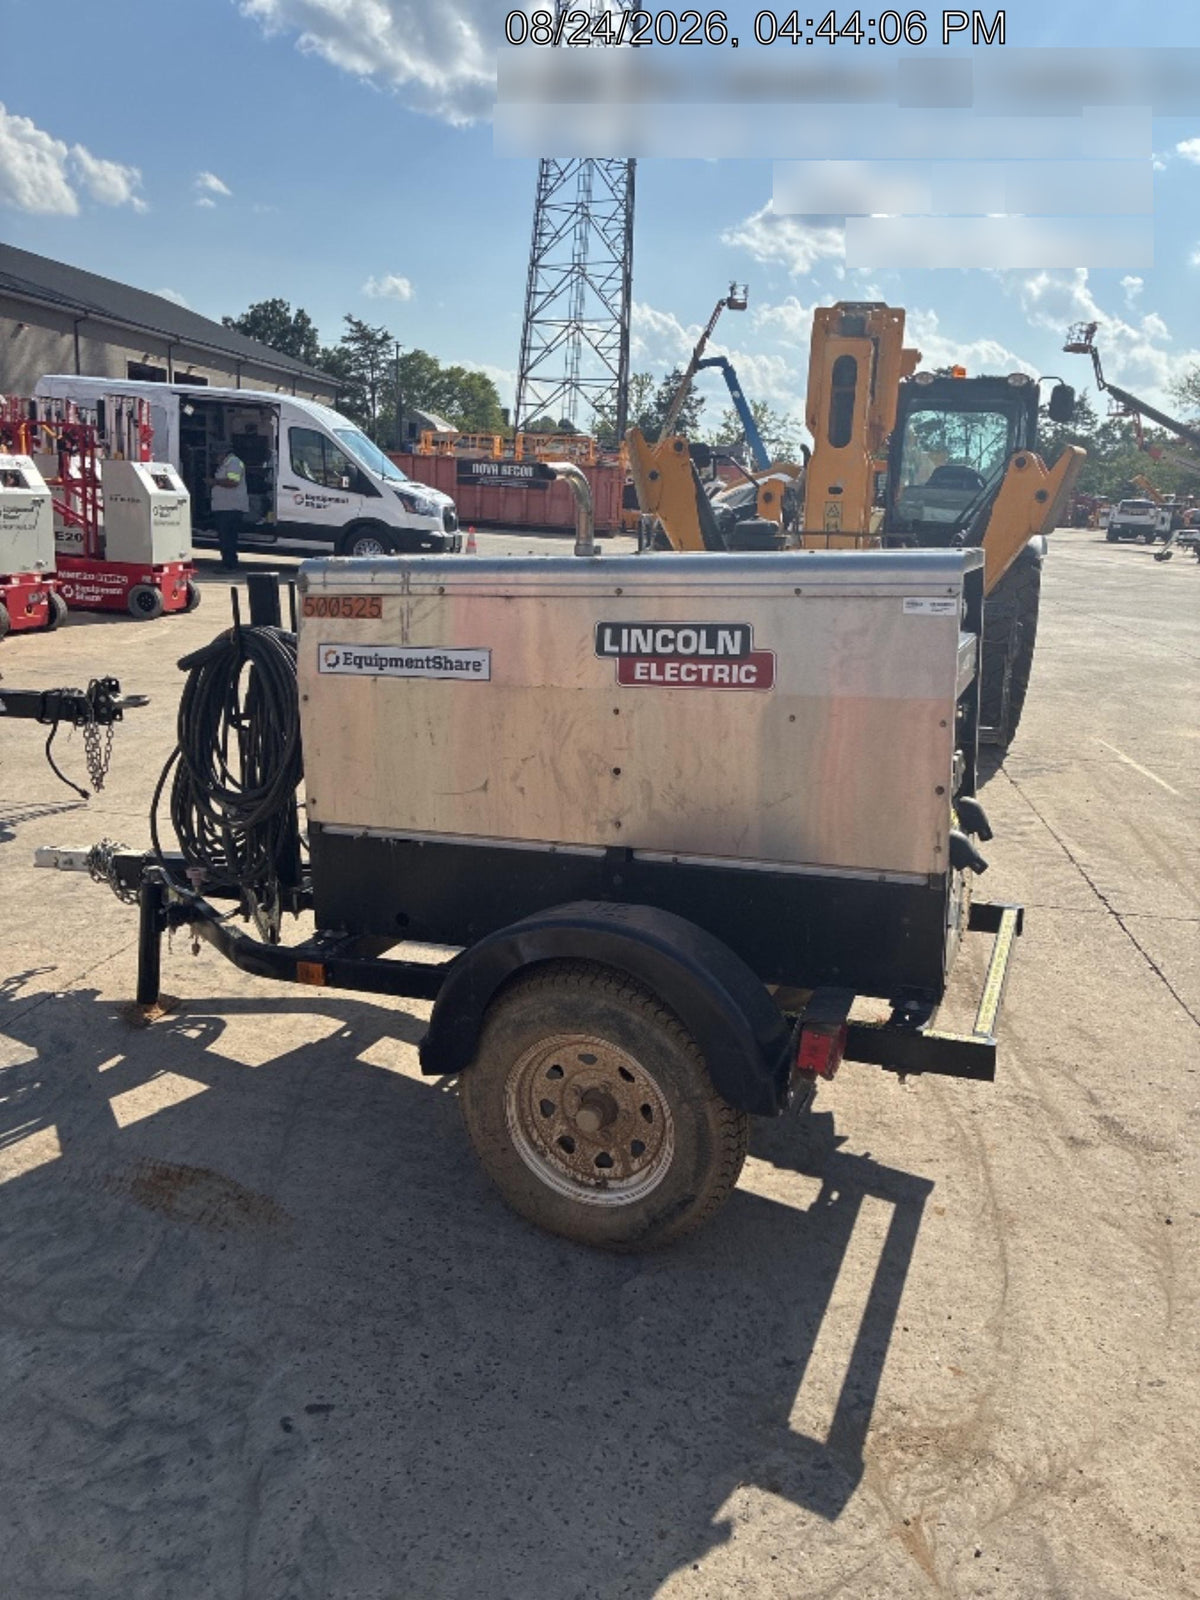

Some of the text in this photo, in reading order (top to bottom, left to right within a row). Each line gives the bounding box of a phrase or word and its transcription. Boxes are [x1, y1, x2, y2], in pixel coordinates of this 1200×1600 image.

[303, 596, 382, 619] 500525
[603, 627, 742, 656] LINCOLN
[342, 650, 484, 674] EquipmentShare
[634, 662, 758, 685] ELECTRIC
